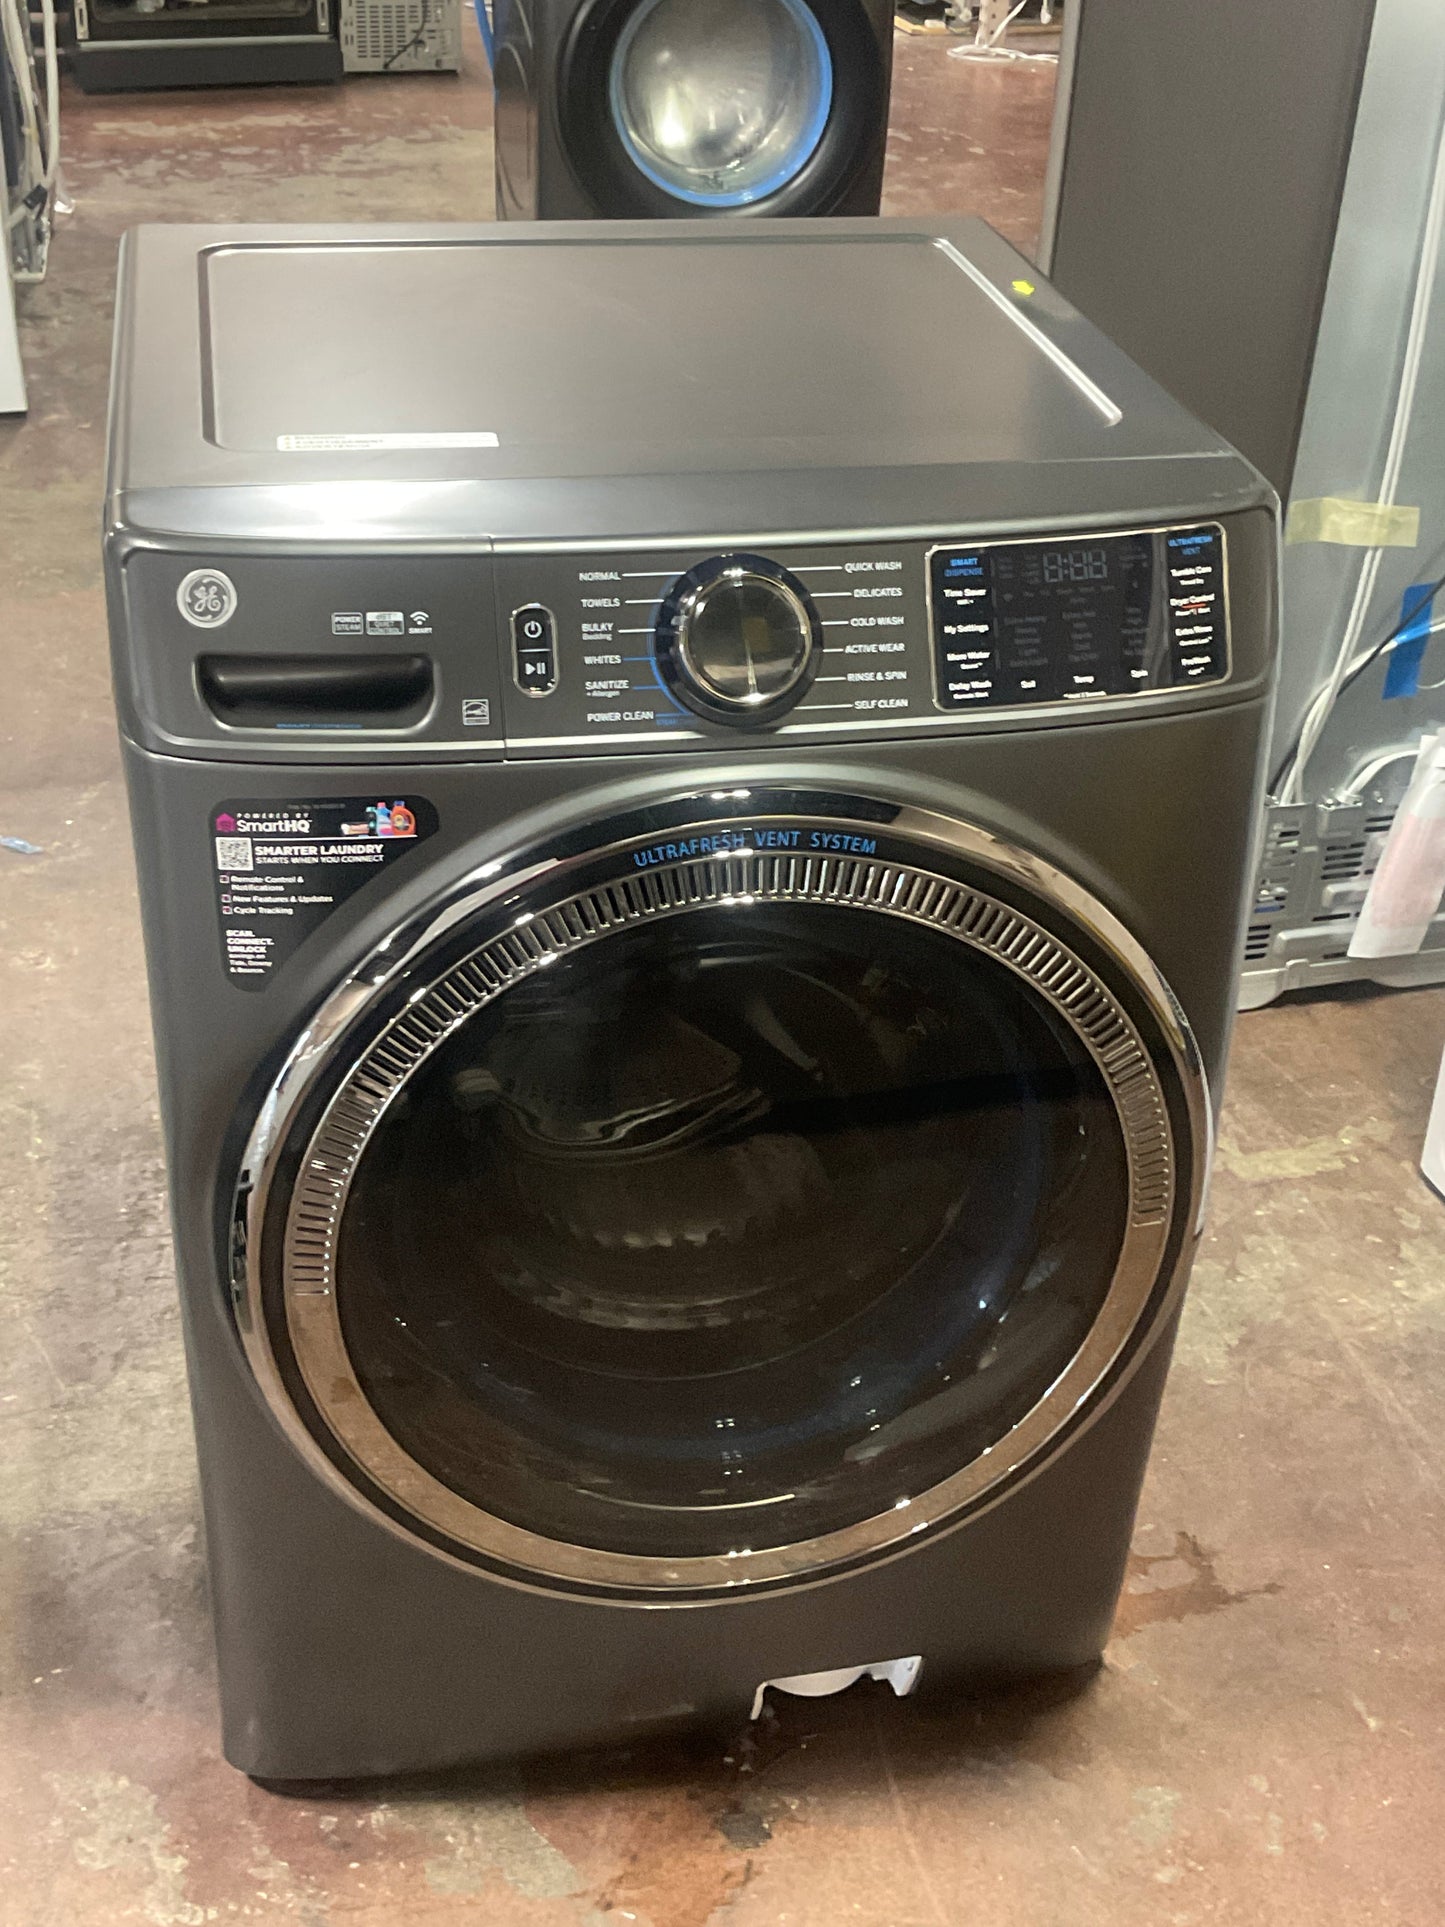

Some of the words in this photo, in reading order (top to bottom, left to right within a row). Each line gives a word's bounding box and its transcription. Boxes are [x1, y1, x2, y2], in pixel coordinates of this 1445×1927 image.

[844, 562, 874, 573] QUICK
[875, 561, 902, 571] WASH
[950, 558, 978, 567] SMART
[578, 571, 621, 581] NORMAL
[853, 587, 903, 598] DELICATES
[580, 597, 621, 608] TOWELS
[581, 622, 614, 632] BULKY
[850, 618, 876, 627] COLD
[877, 616, 904, 625] WASH
[957, 624, 989, 634] Settings
[845, 645, 878, 654] ACTIVE
[878, 643, 906, 653] WEAR
[584, 655, 622, 665] WHITES
[847, 673, 875, 682] RINSE
[876, 672, 884, 681] &
[884, 671, 907, 681] SPIN
[585, 680, 629, 691] SANITIZE
[854, 700, 876, 710] SELF
[877, 699, 909, 709] CLEAN
[587, 712, 621, 722] POWER
[623, 711, 654, 720] CLEAN
[236, 819, 311, 834] SmartHQ
[255, 845, 318, 856] SMARTER
[319, 844, 384, 855] LAUNDRY
[633, 832, 745, 867] ULTRAFRESH
[754, 831, 801, 847] VENT
[810, 832, 877, 854] SYSTEM
[256, 856, 289, 864] STARTS
[320, 855, 340, 863] YOU
[340, 854, 384, 863] CONNECT
[264, 876, 296, 884] Control
[231, 884, 285, 892] Notifications
[298, 896, 334, 904] Updates
[233, 907, 257, 915] Cycle
[258, 907, 294, 916] Tracking
[227, 945, 268, 954] UNLOCK
